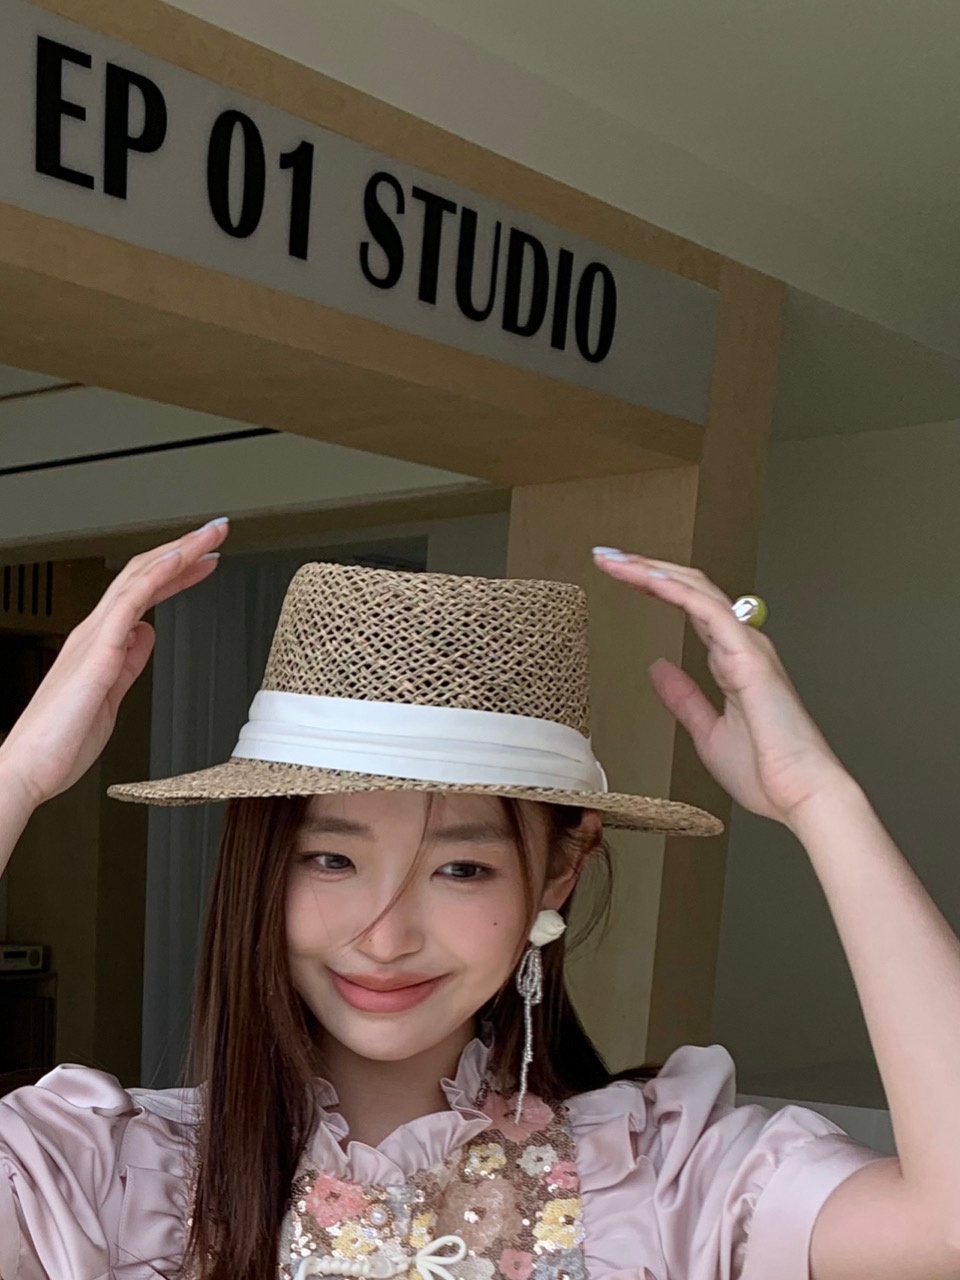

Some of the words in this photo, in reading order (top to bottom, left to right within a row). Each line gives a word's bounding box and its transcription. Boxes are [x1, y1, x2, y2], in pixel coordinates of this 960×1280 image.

[36, 35, 168, 200] EP
[207, 109, 314, 261] 01
[359, 172, 617, 364] STUDIO
